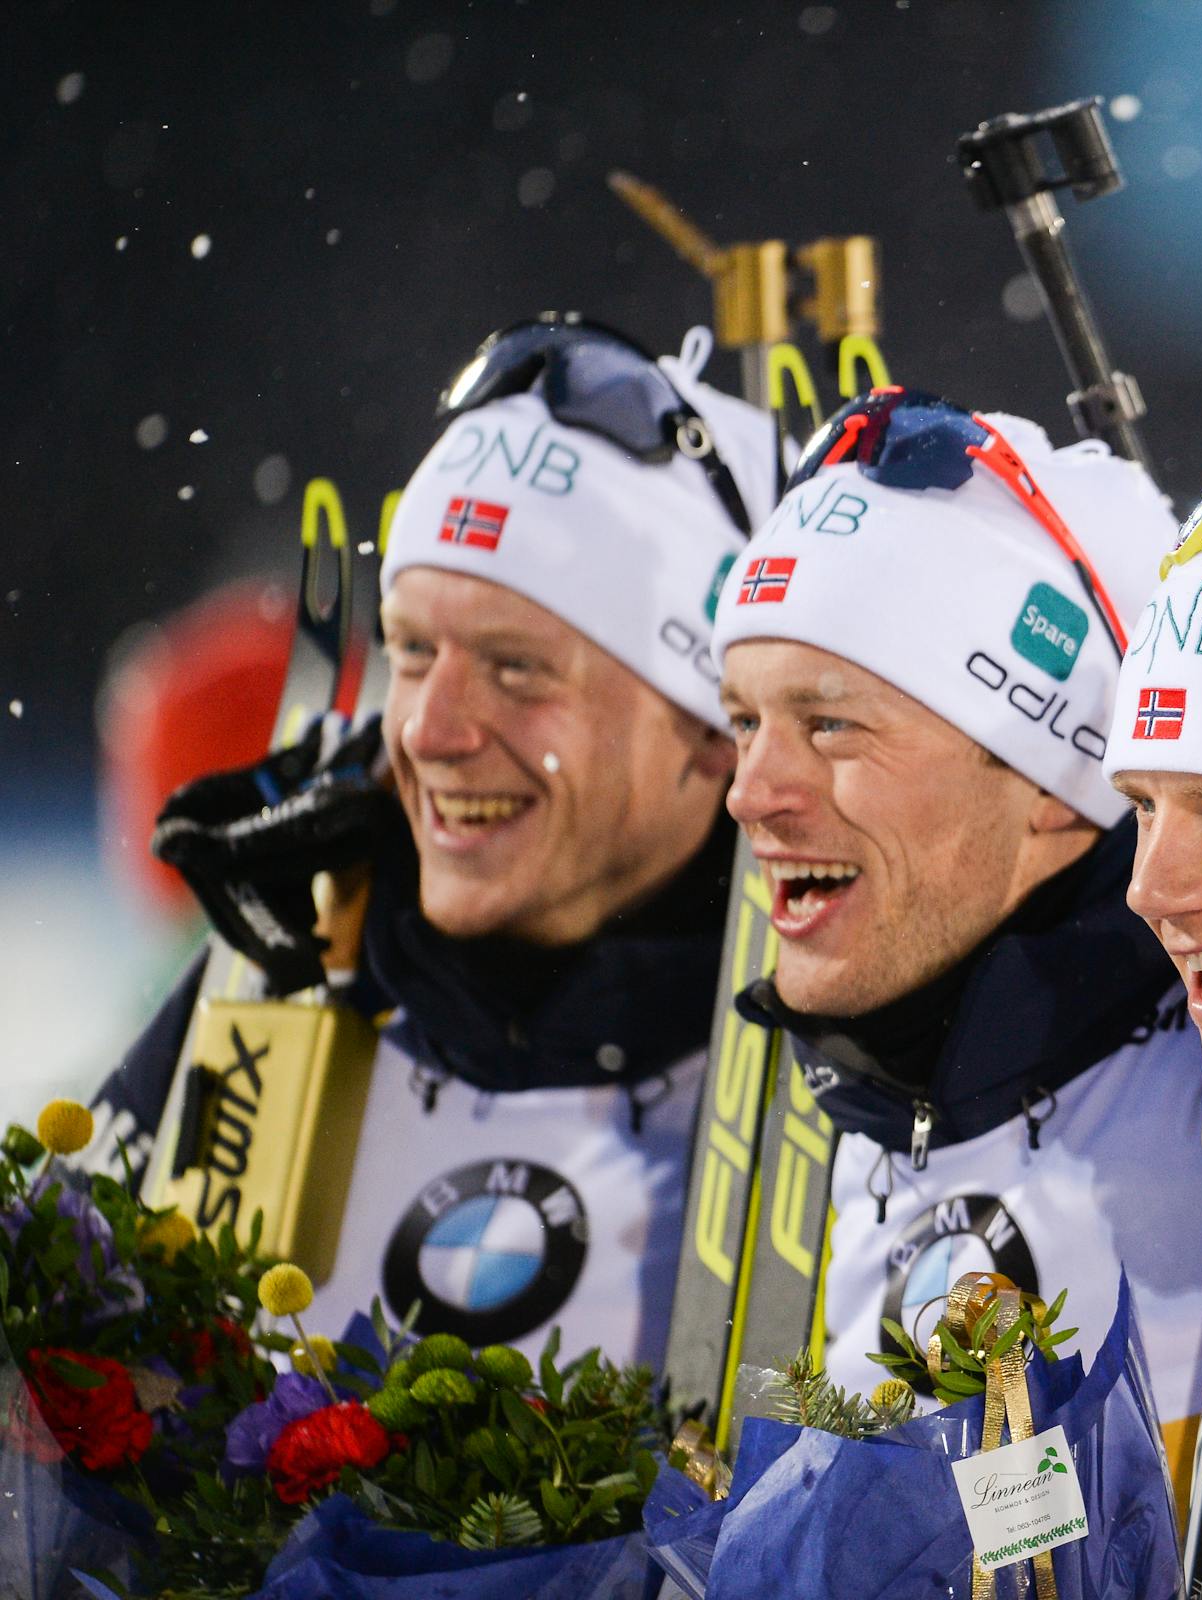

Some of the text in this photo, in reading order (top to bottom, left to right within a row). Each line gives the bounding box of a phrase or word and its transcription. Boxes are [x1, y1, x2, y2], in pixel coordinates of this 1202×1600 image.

[1022, 604, 1078, 657] Spare
[966, 650, 1107, 761] odlo
[970, 1471, 1054, 1510] Linnean
